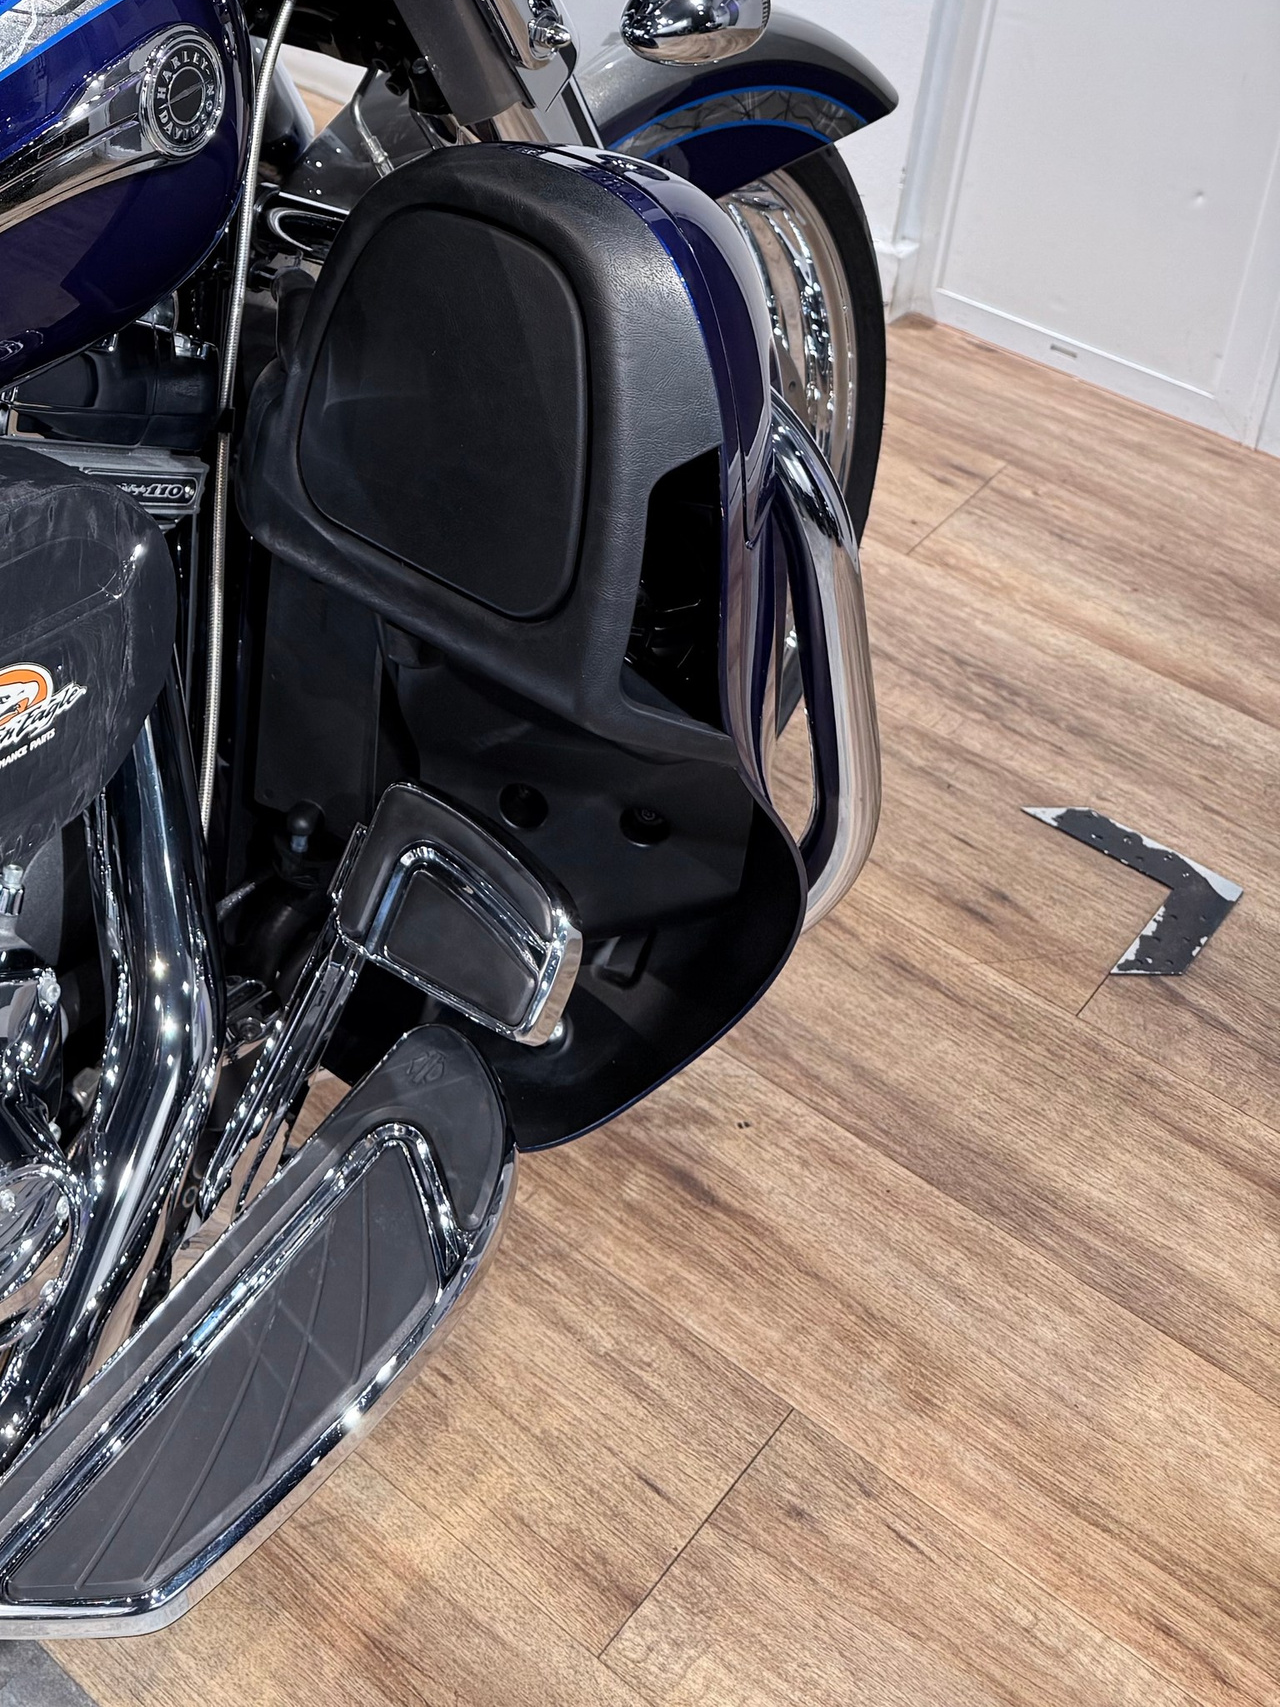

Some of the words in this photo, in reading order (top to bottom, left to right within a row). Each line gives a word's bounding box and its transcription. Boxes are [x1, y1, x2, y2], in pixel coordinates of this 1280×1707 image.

[142, 483, 184, 499] 110
[16, 686, 80, 738] Eagle
[29, 728, 56, 751] PARTS
